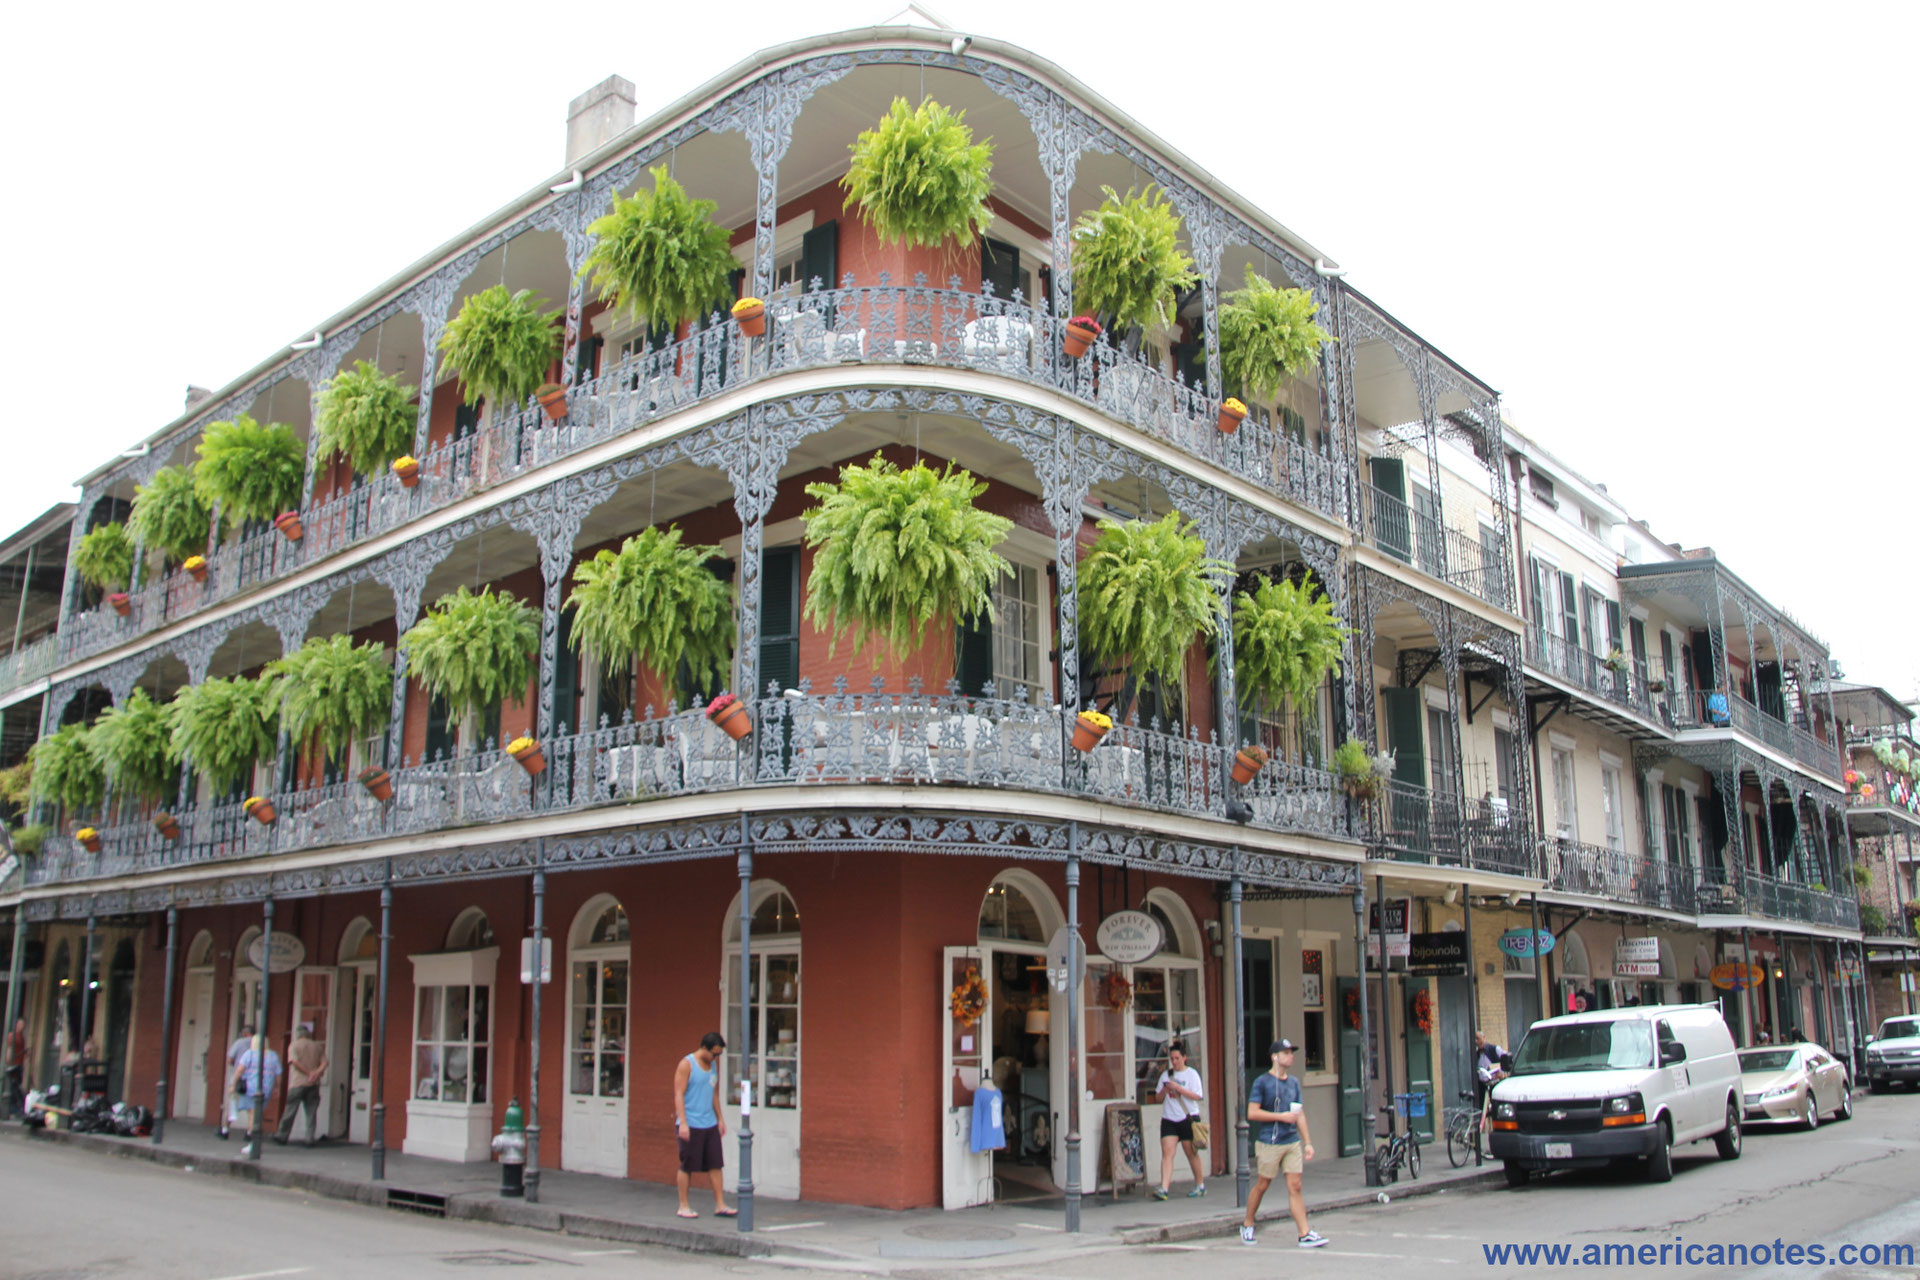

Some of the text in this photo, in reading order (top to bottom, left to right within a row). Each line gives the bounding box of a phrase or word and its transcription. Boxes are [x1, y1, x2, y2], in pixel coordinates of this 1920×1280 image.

[1105, 915, 1151, 933] FOREVER
[1617, 938, 1656, 947] Discount
[1413, 945, 1461, 959] bijounola
[1617, 963, 1657, 973] ATM INSIDE
